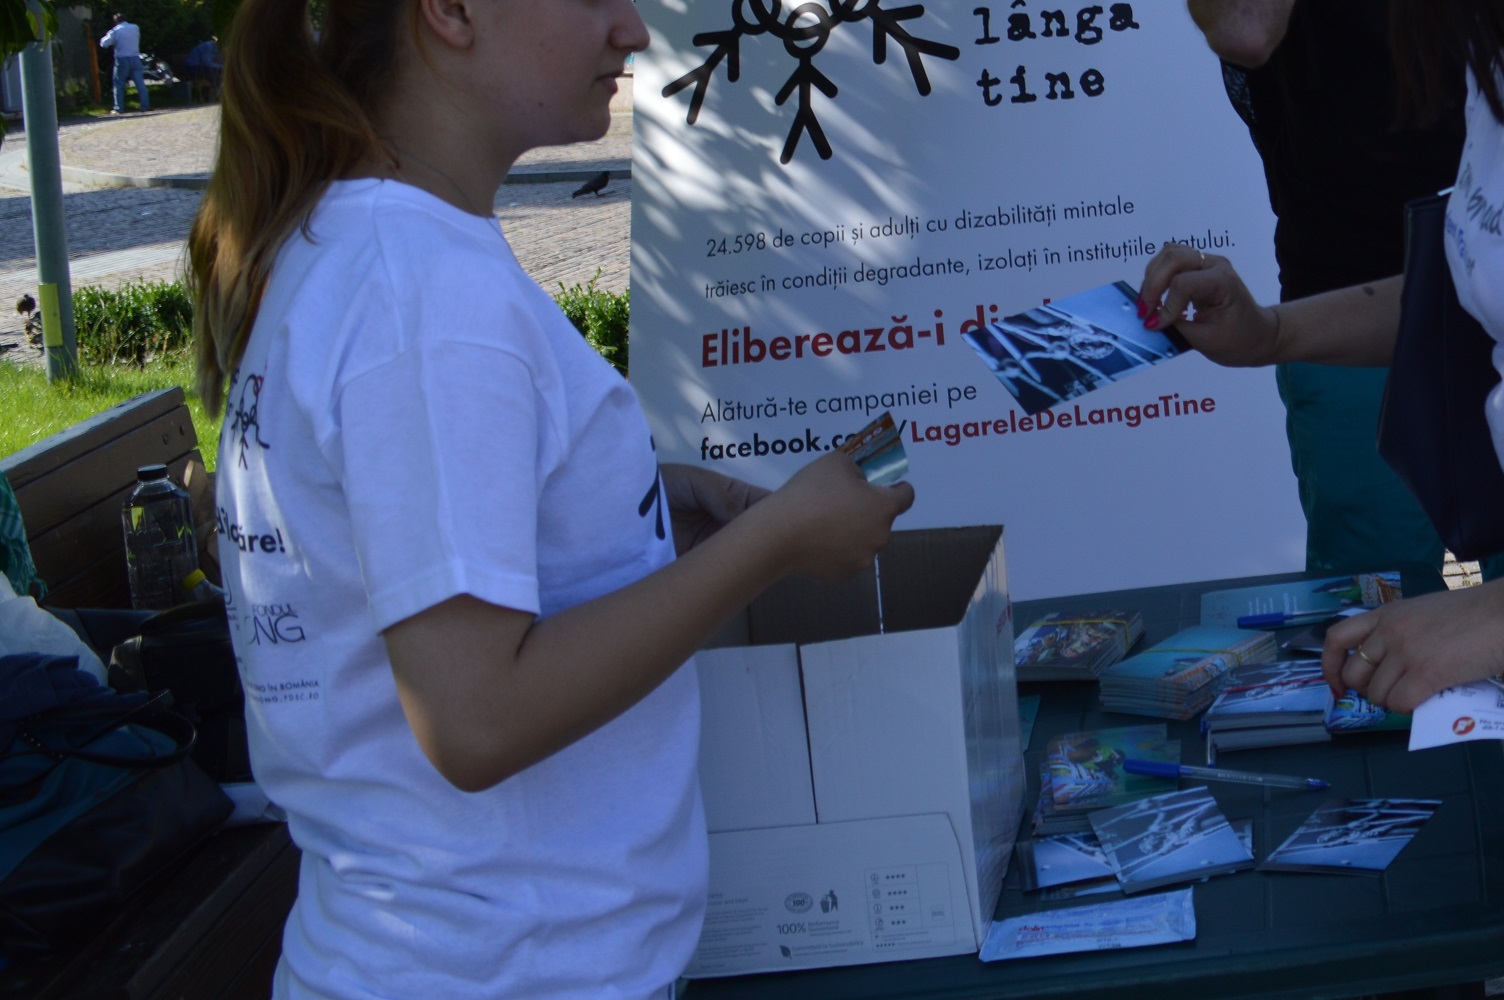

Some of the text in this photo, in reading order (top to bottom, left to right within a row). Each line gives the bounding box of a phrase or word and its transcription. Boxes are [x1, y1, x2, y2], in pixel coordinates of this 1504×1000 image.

[976, 65, 1107, 107] tine
[706, 232, 767, 258] 24.598
[772, 228, 795, 249] de
[800, 225, 846, 249] copii
[869, 215, 920, 240] adulți
[926, 218, 948, 233] cu
[954, 204, 1057, 231] dizabilități
[1063, 195, 1135, 220] mintale
[705, 277, 756, 299] trăiesc
[761, 274, 776, 293] în
[781, 265, 848, 291] condiții
[853, 257, 970, 286] degradante,
[976, 250, 1038, 275] izolați
[1044, 248, 1062, 266] în
[1068, 235, 1157, 264] instituțiile
[702, 308, 946, 368] Eliberează-i
[701, 382, 978, 424] Alătură-te campaniei pe
[776, 922, 807, 936] 100%
